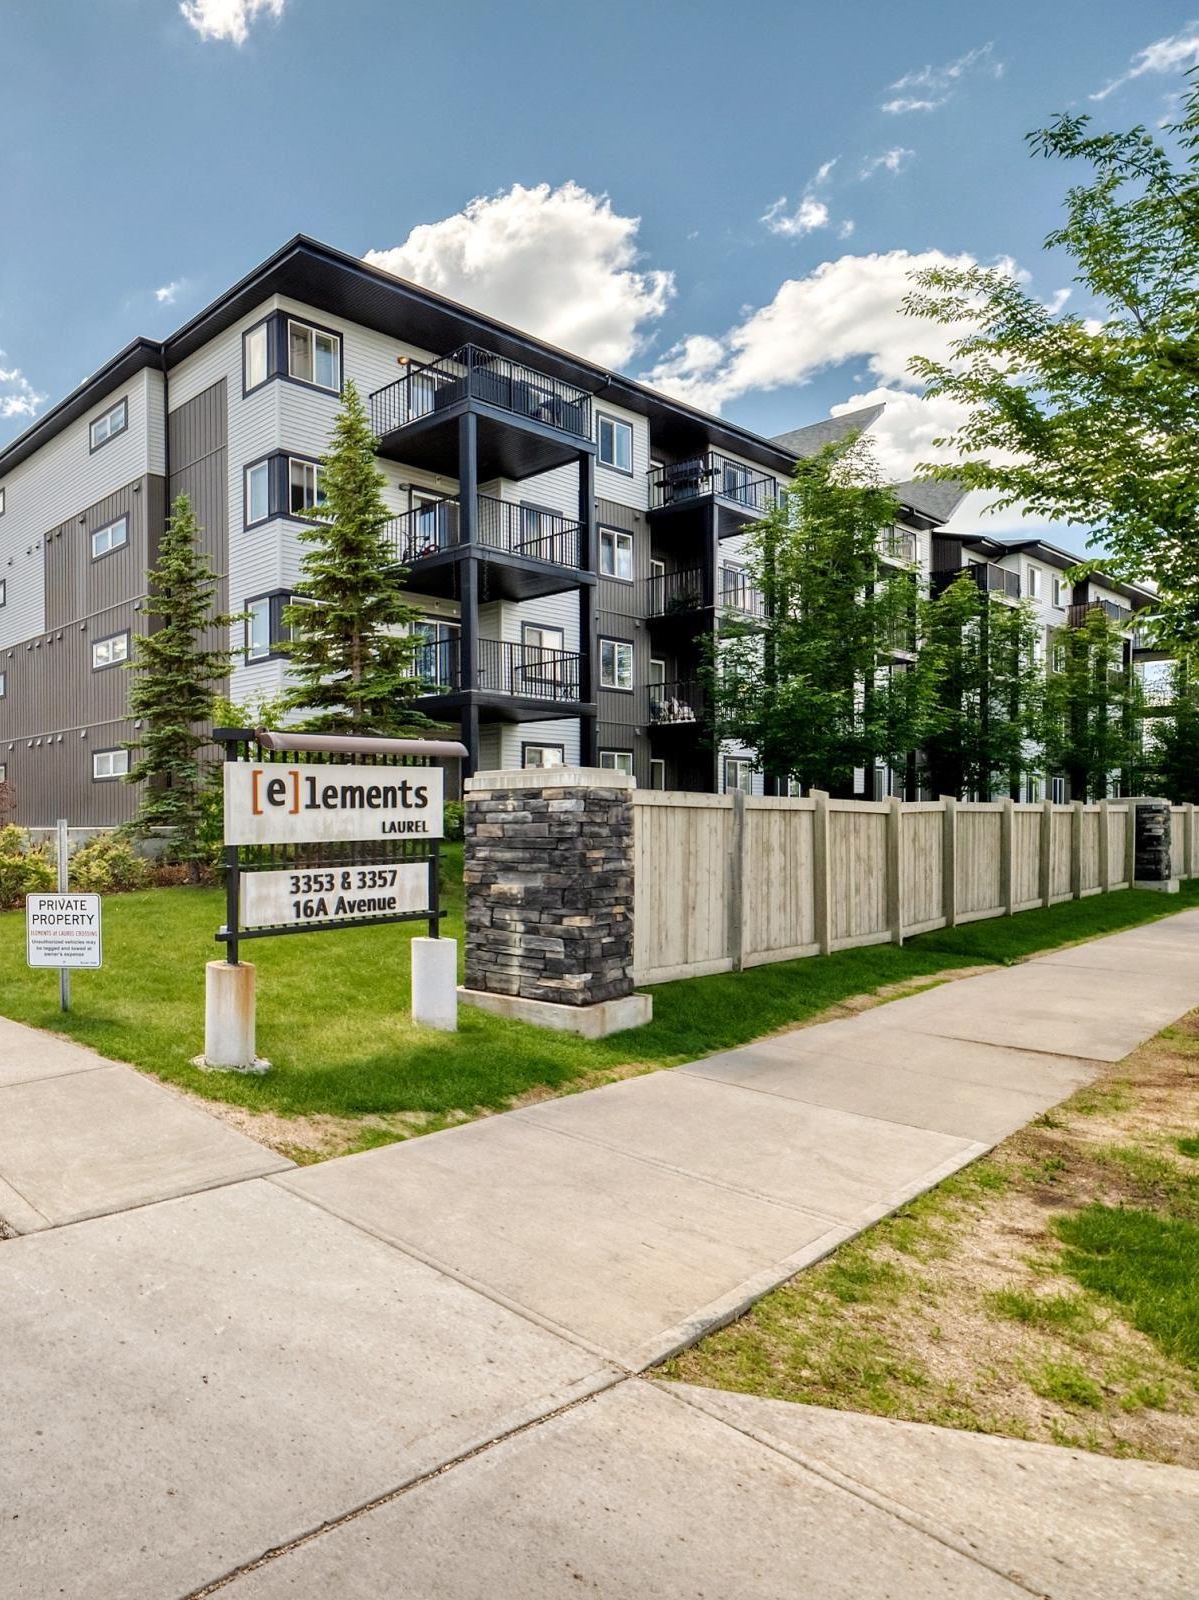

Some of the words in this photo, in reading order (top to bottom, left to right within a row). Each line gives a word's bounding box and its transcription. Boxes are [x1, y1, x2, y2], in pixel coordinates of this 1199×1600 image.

[381, 820, 429, 834] LAUREL
[289, 873, 335, 895] 3353
[340, 871, 352, 890] &
[357, 869, 398, 889] 3357
[38, 900, 88, 910] PRIVATE
[292, 897, 329, 919] 16A
[334, 895, 397, 915] Avenue
[32, 914, 94, 925] PROPERTY
